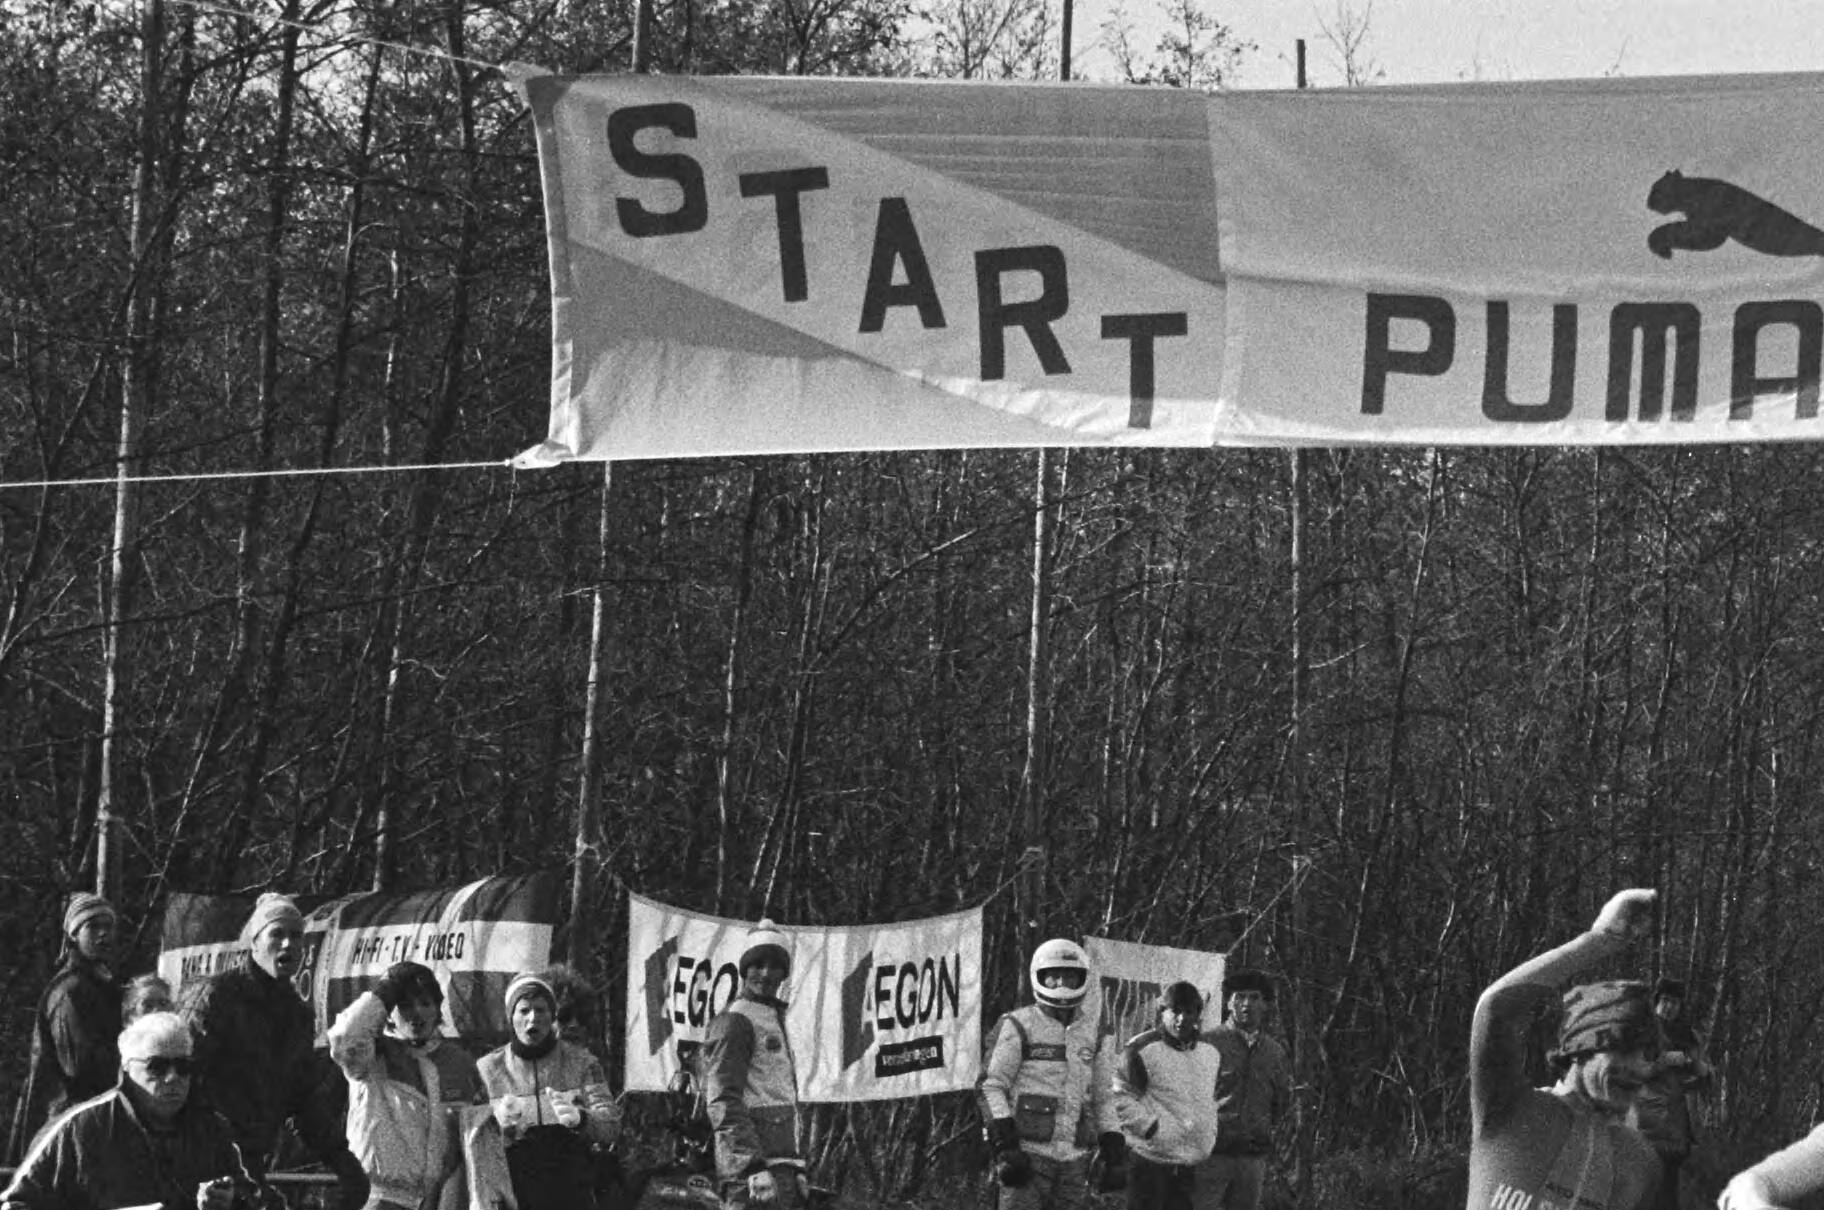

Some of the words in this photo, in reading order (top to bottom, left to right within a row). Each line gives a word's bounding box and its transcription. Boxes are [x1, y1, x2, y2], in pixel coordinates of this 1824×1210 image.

[607, 102, 1188, 430] START
[1360, 292, 1824, 423] PUMA
[424, 931, 466, 961] VIDEO
